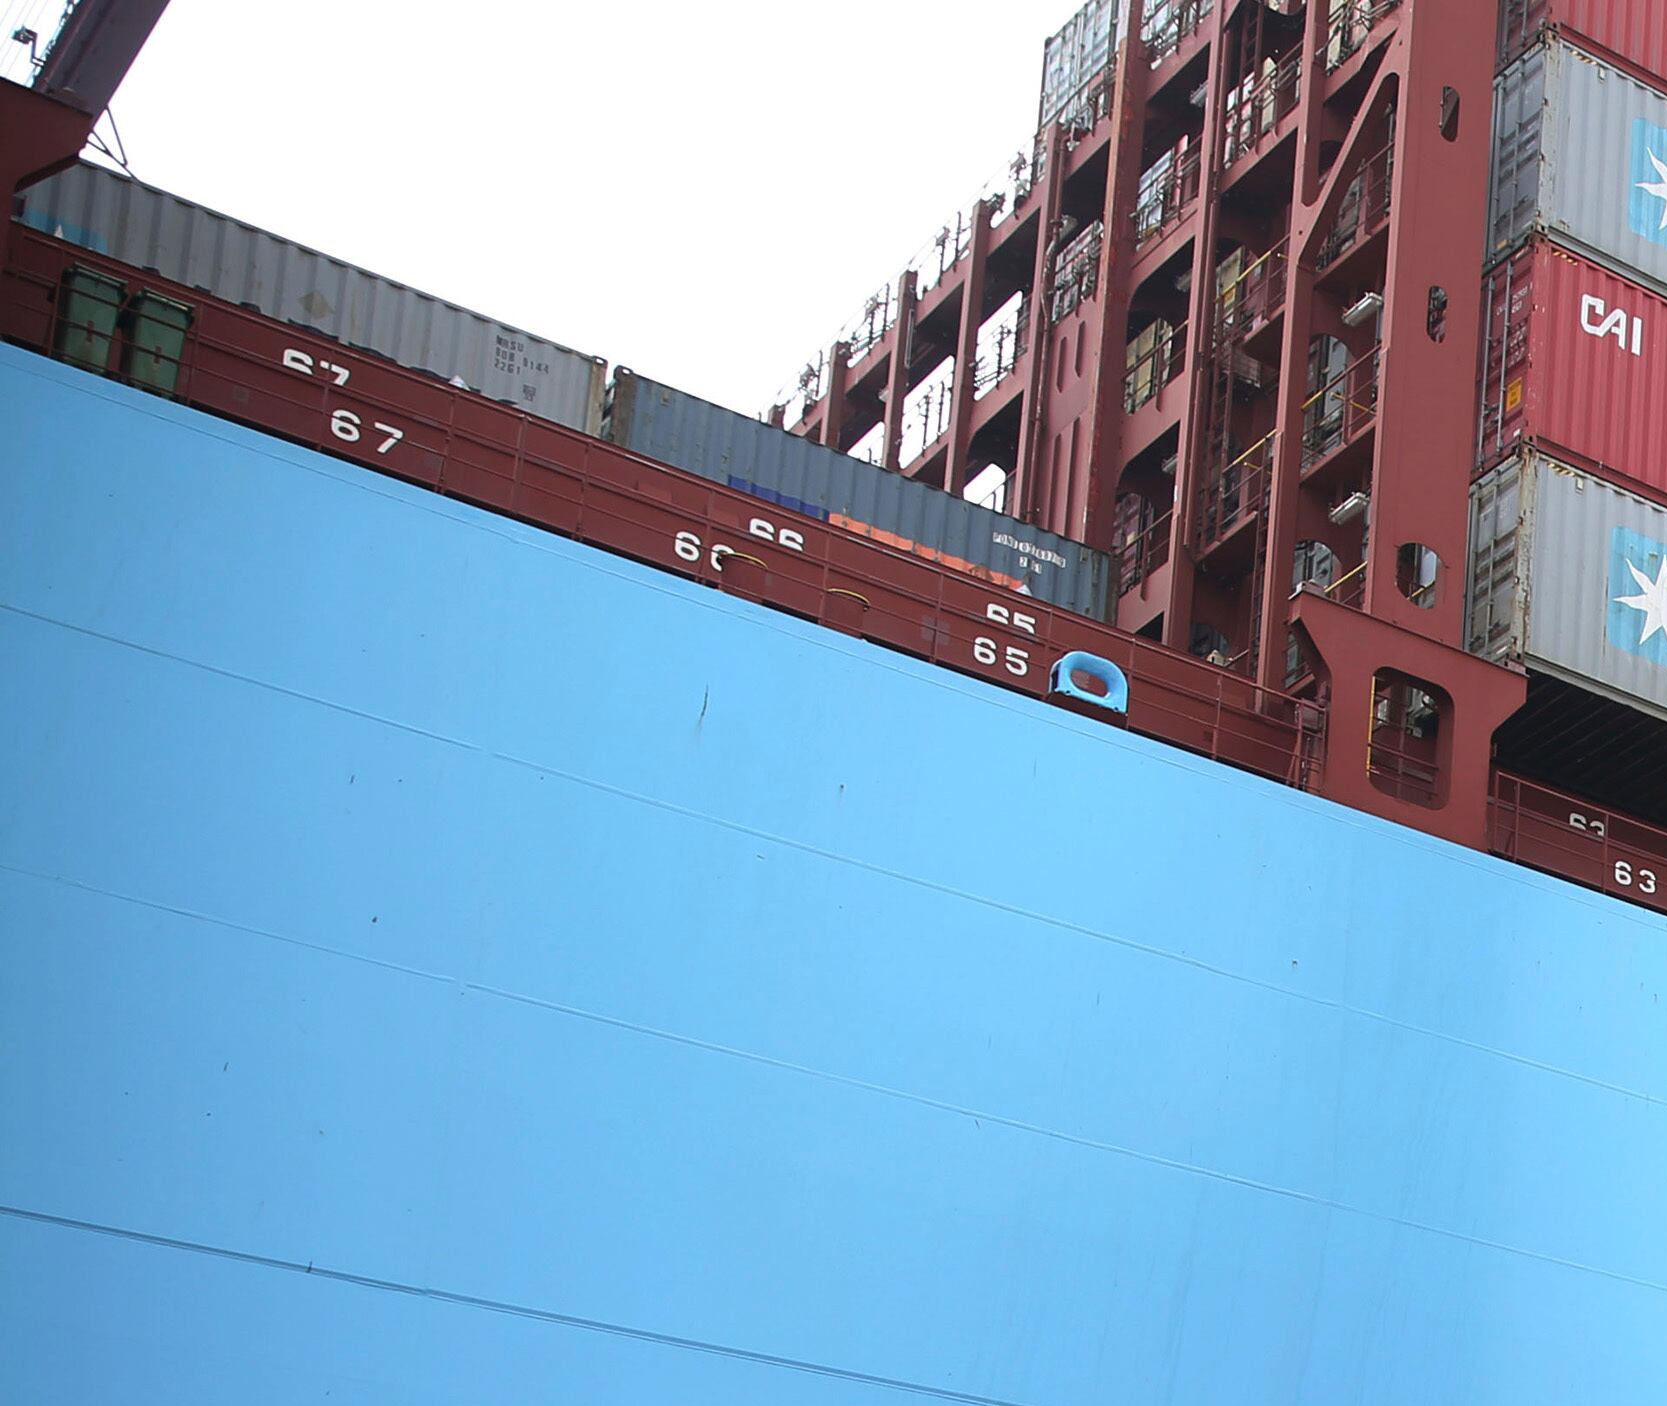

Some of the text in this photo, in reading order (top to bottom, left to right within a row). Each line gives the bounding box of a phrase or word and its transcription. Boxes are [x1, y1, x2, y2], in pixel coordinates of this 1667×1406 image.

[1580, 293, 1643, 357] CAI
[330, 409, 404, 454] 67
[973, 636, 1029, 676] 65
[1614, 860, 1657, 894] 63
